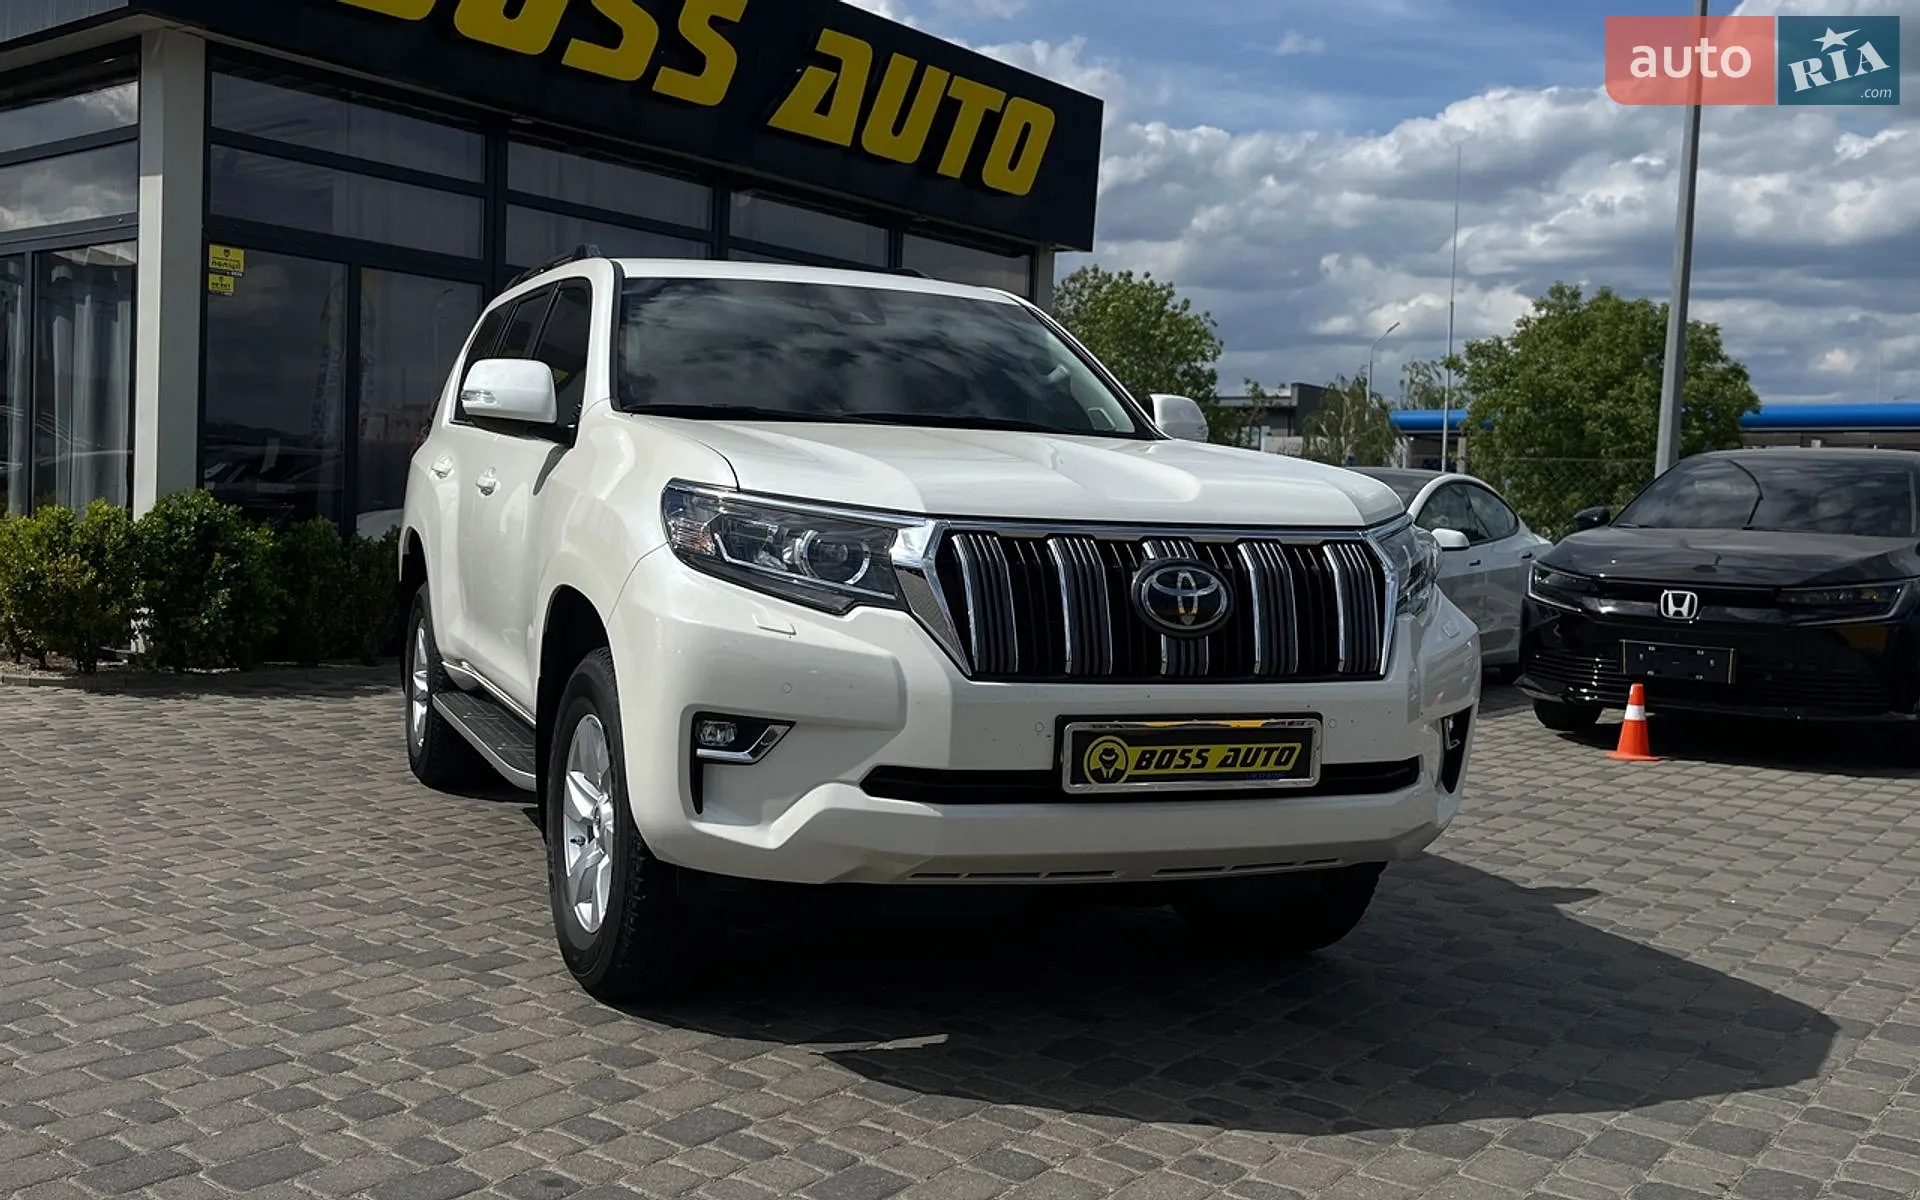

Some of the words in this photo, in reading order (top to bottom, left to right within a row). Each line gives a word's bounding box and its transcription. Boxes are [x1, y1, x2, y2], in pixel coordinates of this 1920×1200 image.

[338, 0, 747, 106] SS
[768, 28, 1056, 196] AUTO
[1132, 748, 1211, 771] BOSS
[1216, 746, 1297, 768] AUTO
